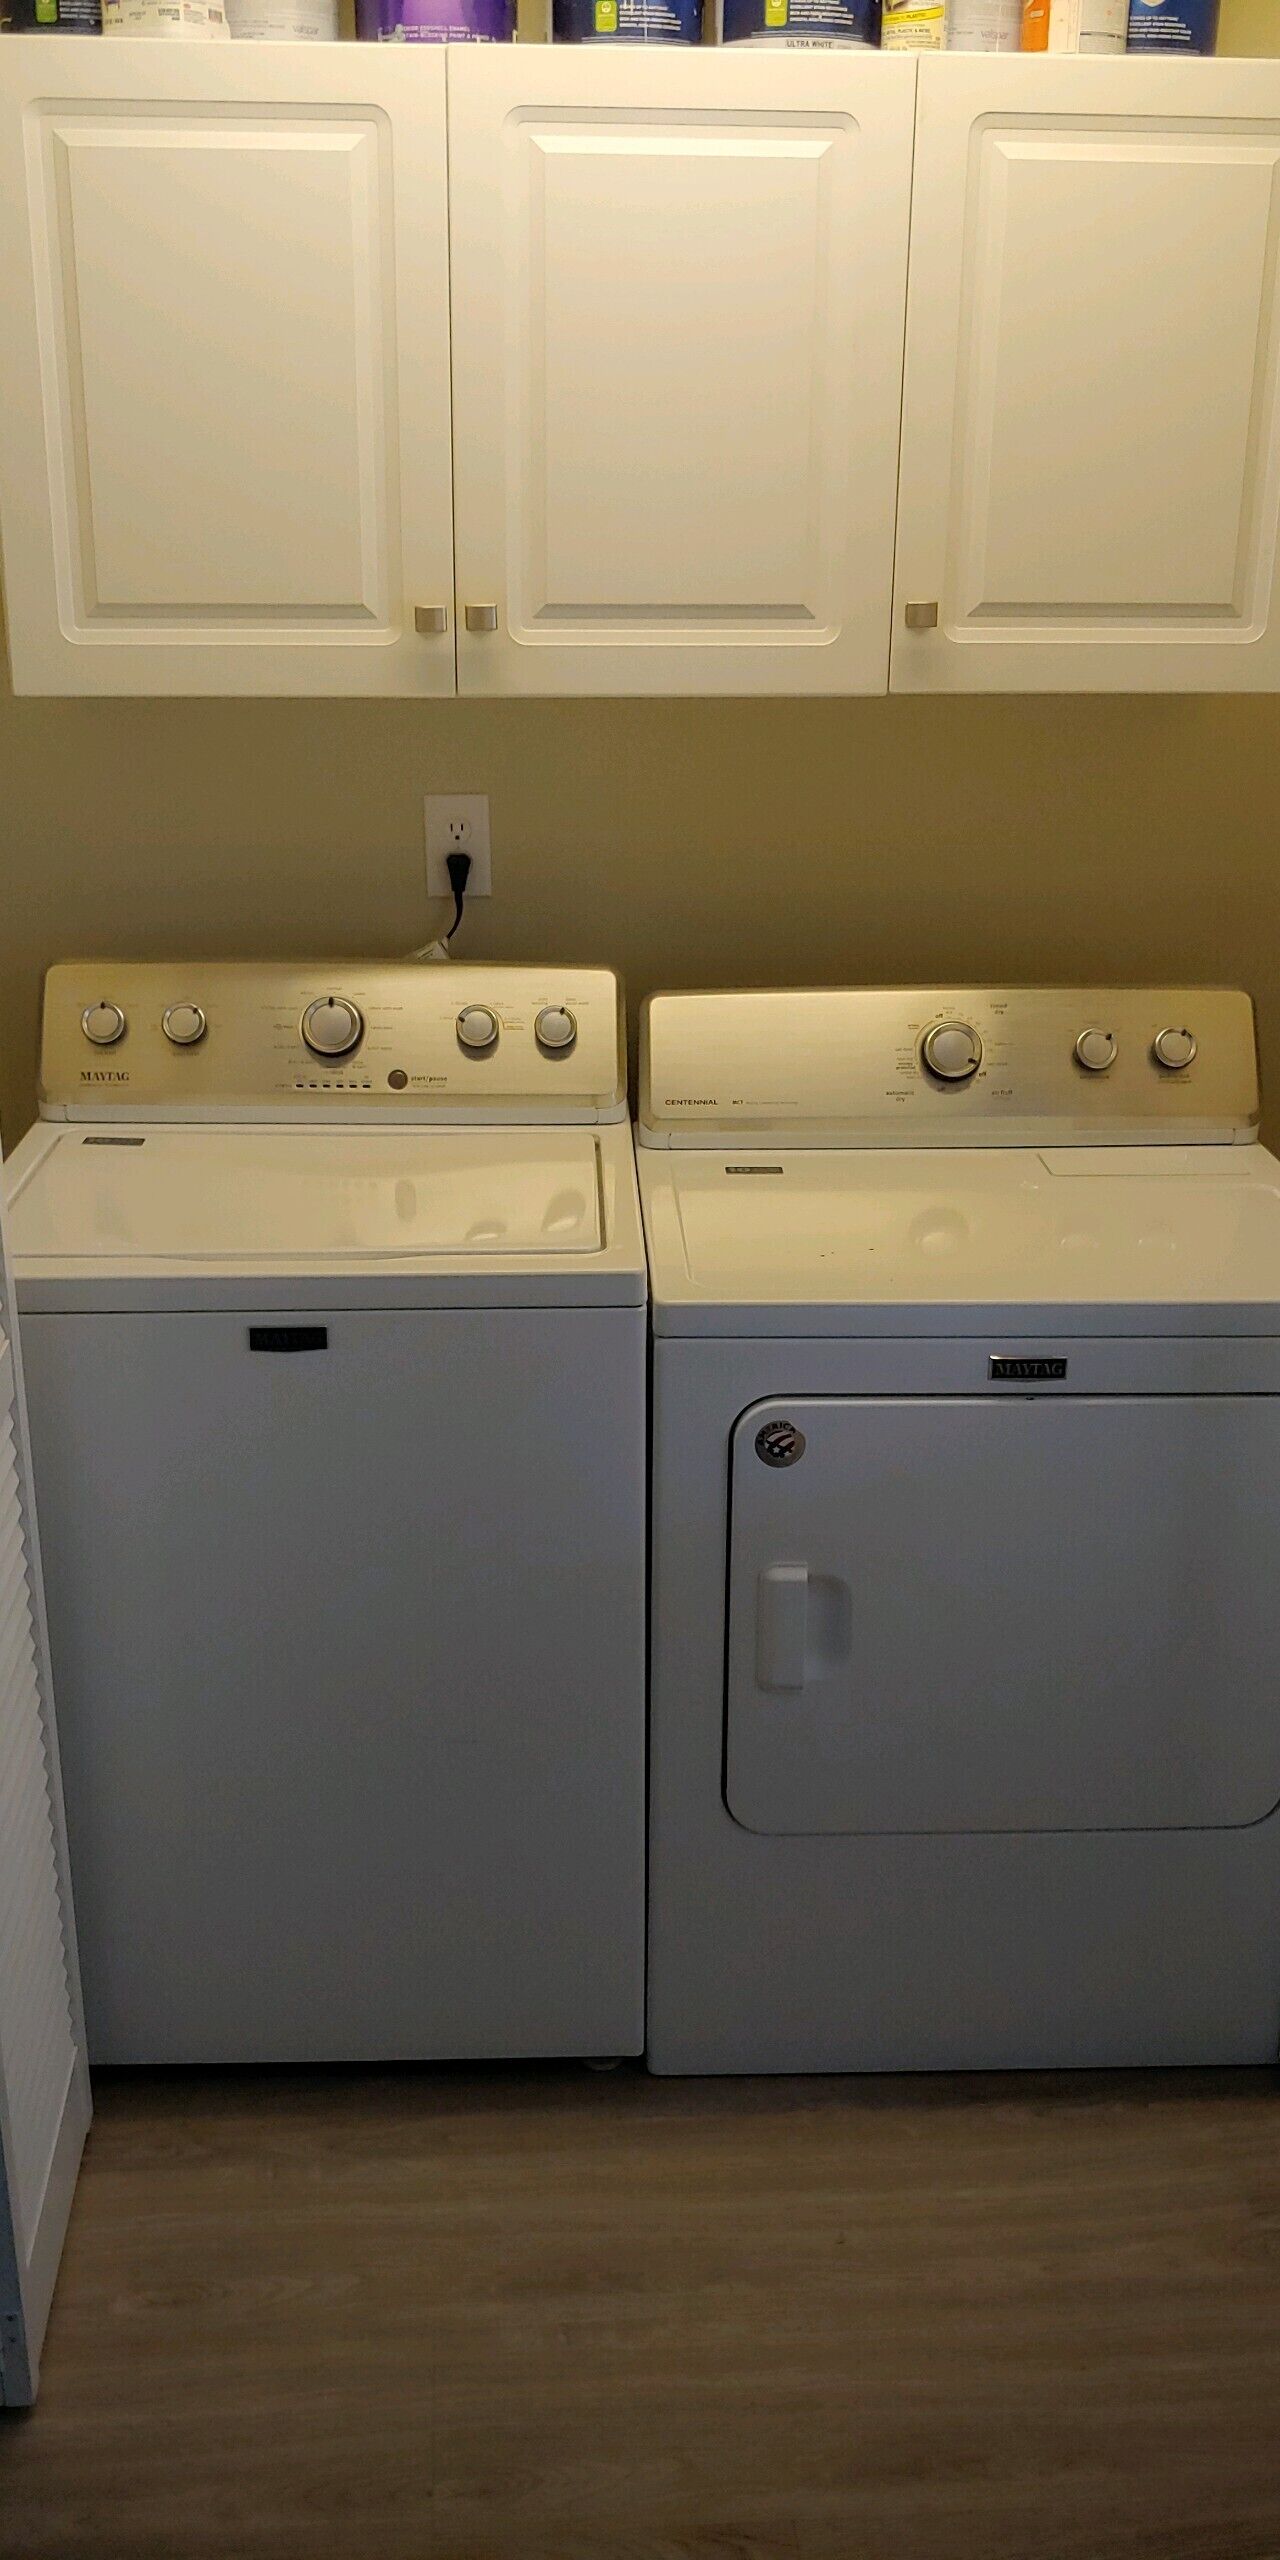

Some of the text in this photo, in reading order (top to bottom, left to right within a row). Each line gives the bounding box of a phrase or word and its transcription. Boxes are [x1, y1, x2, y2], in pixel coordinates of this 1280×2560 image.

[786, 40, 834, 48] ULTRA WHITE
[80, 1071, 130, 1081] MAYTAG
[995, 1363, 1063, 1376] MAYTAG
